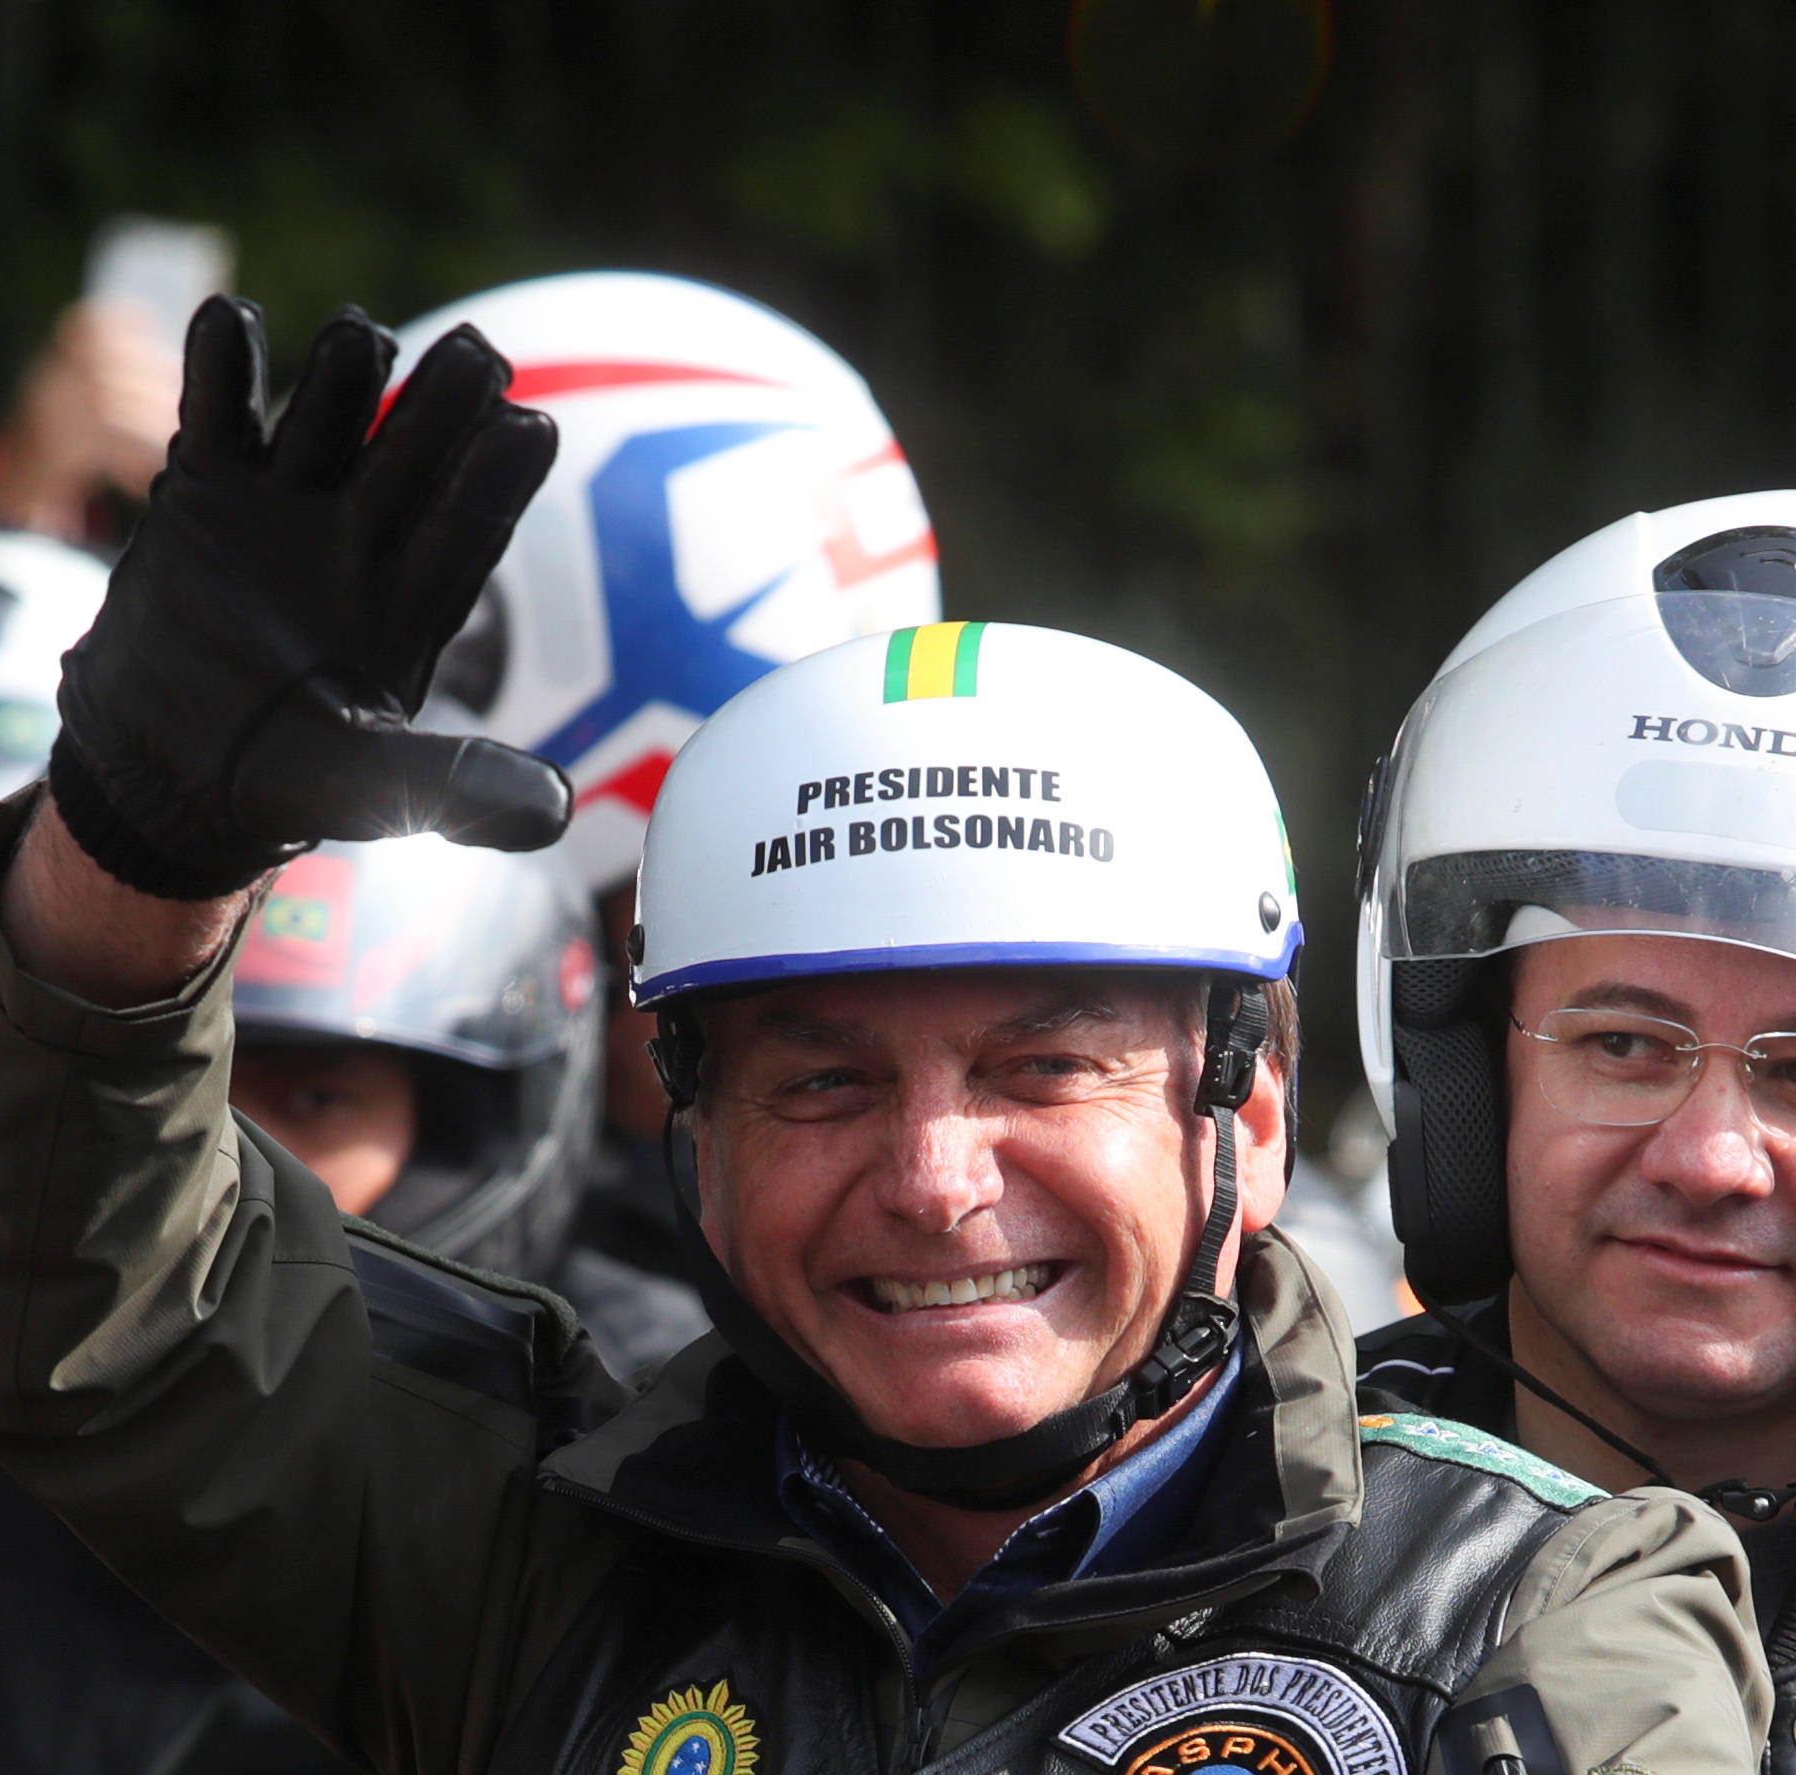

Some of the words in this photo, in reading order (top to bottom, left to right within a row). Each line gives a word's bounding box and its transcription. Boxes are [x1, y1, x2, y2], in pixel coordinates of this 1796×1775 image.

[796, 765, 1062, 816] PRESIDENTE
[750, 826, 836, 878] JAIR
[848, 814, 1115, 863] BOLSONARO
[1233, 1664, 1281, 1697] DOS
